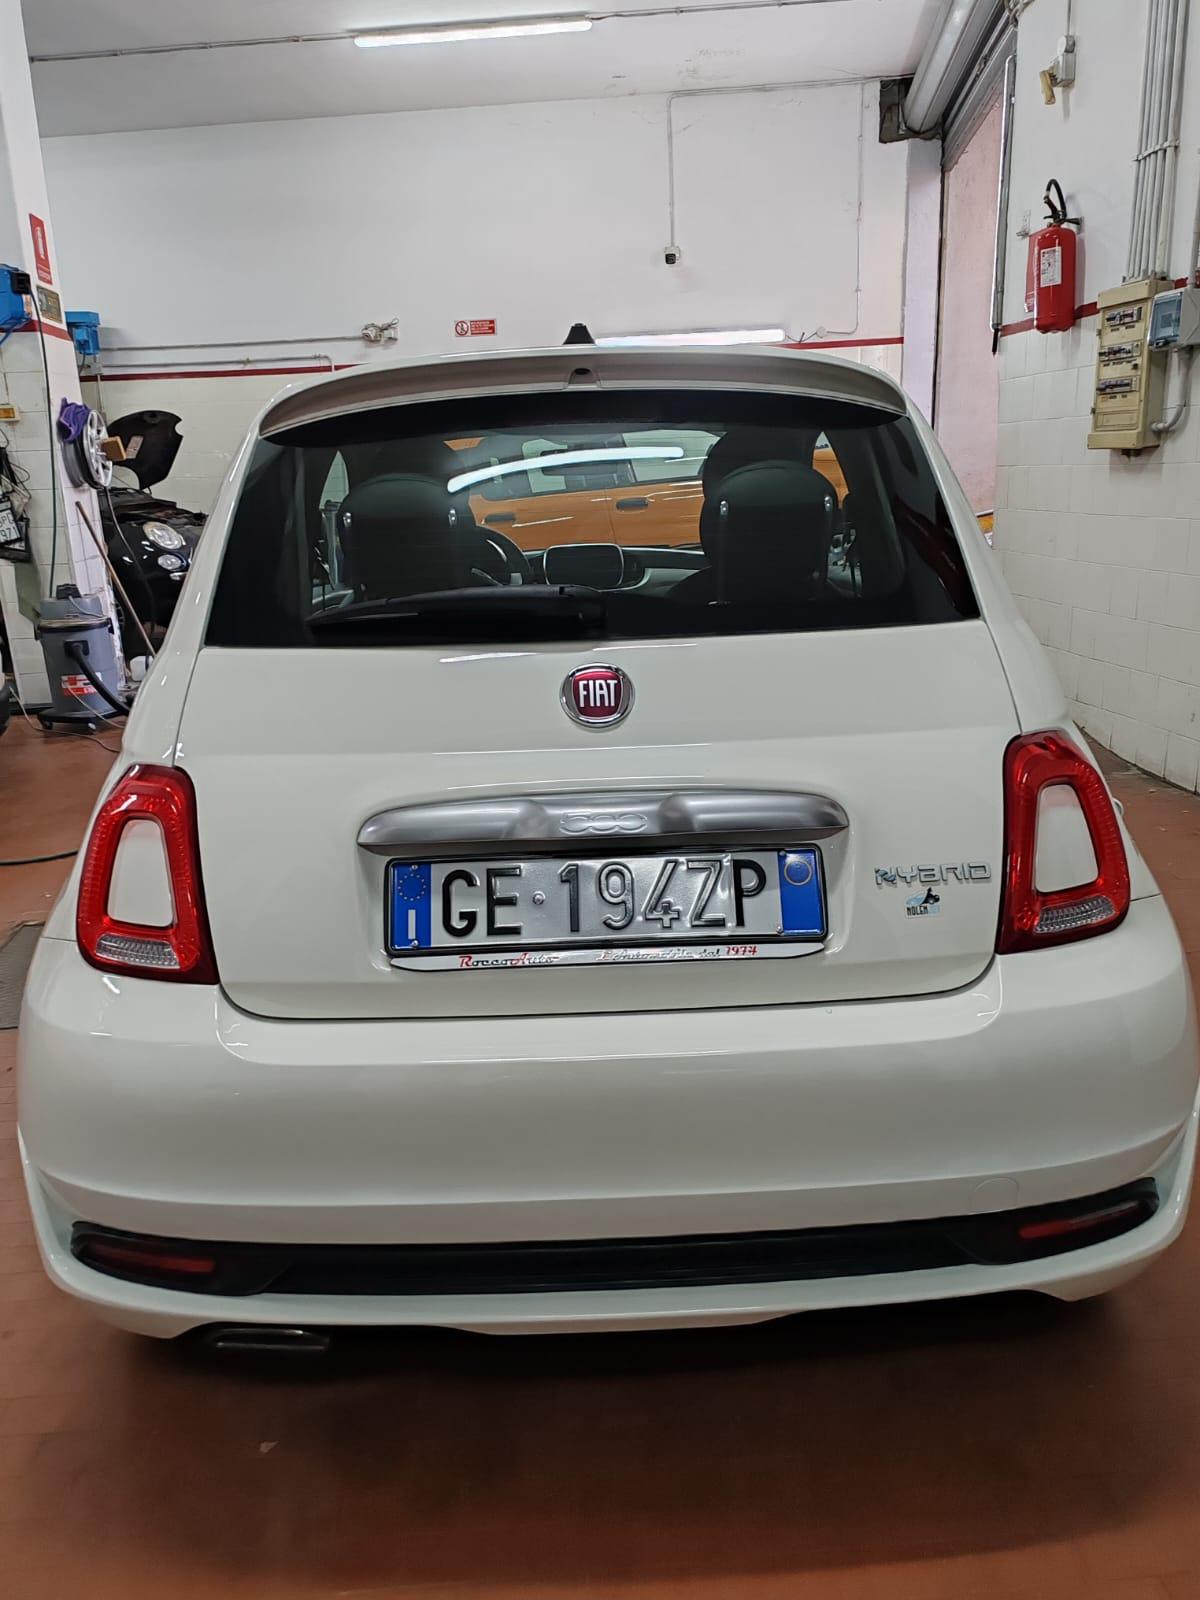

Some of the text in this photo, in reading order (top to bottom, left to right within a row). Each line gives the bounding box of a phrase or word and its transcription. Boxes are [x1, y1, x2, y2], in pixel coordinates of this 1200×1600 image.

[578, 679, 617, 707] FIAT
[560, 813, 648, 834] 500
[874, 862, 992, 886] HYBRID
[442, 858, 768, 938] GE 194ZP
[725, 946, 757, 956] 1974
